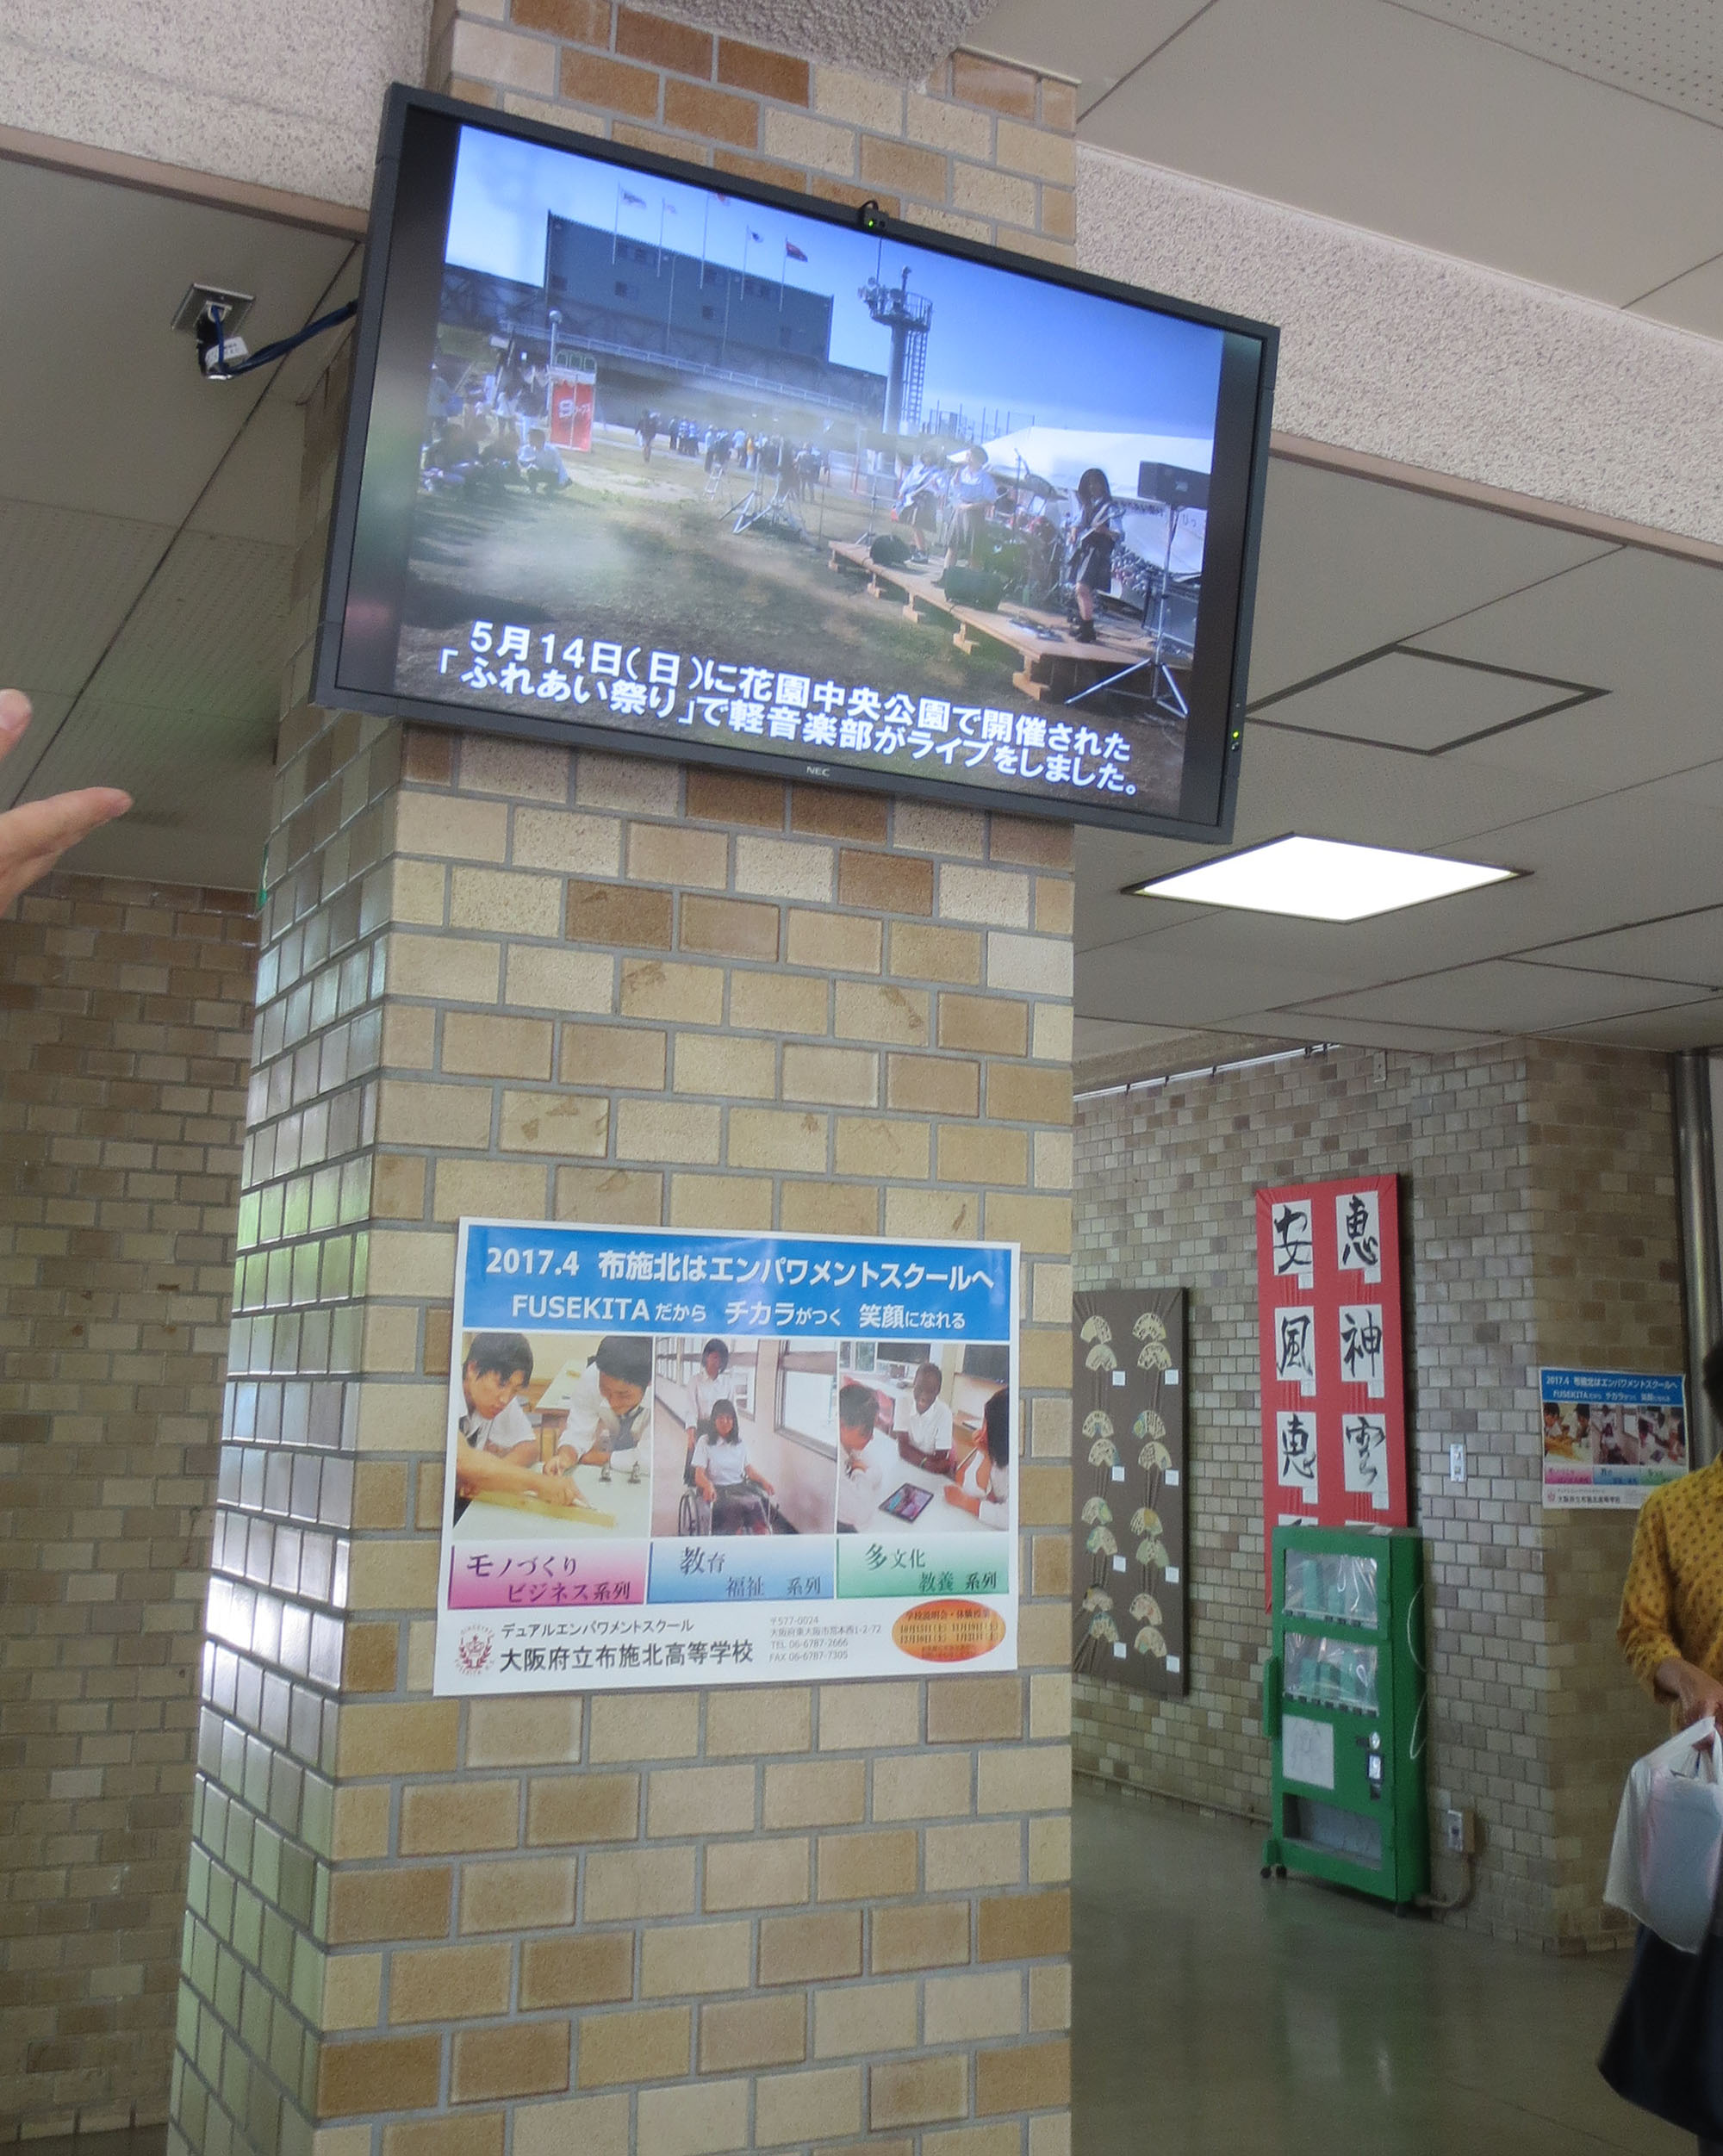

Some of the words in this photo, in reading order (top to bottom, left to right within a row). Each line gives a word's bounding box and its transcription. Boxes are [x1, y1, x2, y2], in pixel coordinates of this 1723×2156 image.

[806, 766, 830, 777] NEC
[486, 1247, 580, 1277] 2017.4
[598, 1250, 995, 1291] 布施北はエンパワメントスクールへ
[725, 1299, 842, 1327] チカラがつく
[859, 1303, 966, 1329] 笑顔になれる
[1276, 1315, 1313, 1377] 風
[1340, 1309, 1384, 1378] 神
[467, 1553, 577, 1578] モノづくり
[680, 1546, 726, 1576] 教育
[865, 1543, 925, 1570] 多文化
[508, 1581, 631, 1604] ビジネス系列
[725, 1576, 764, 1598] 福祉
[786, 1575, 821, 1596] 系列
[918, 1571, 954, 1593] 教養
[965, 1571, 998, 1591] 系列
[501, 1619, 694, 1639] デュアルエンパワメントスクール
[500, 1639, 754, 1673] 大阪府立布施北高等学校
